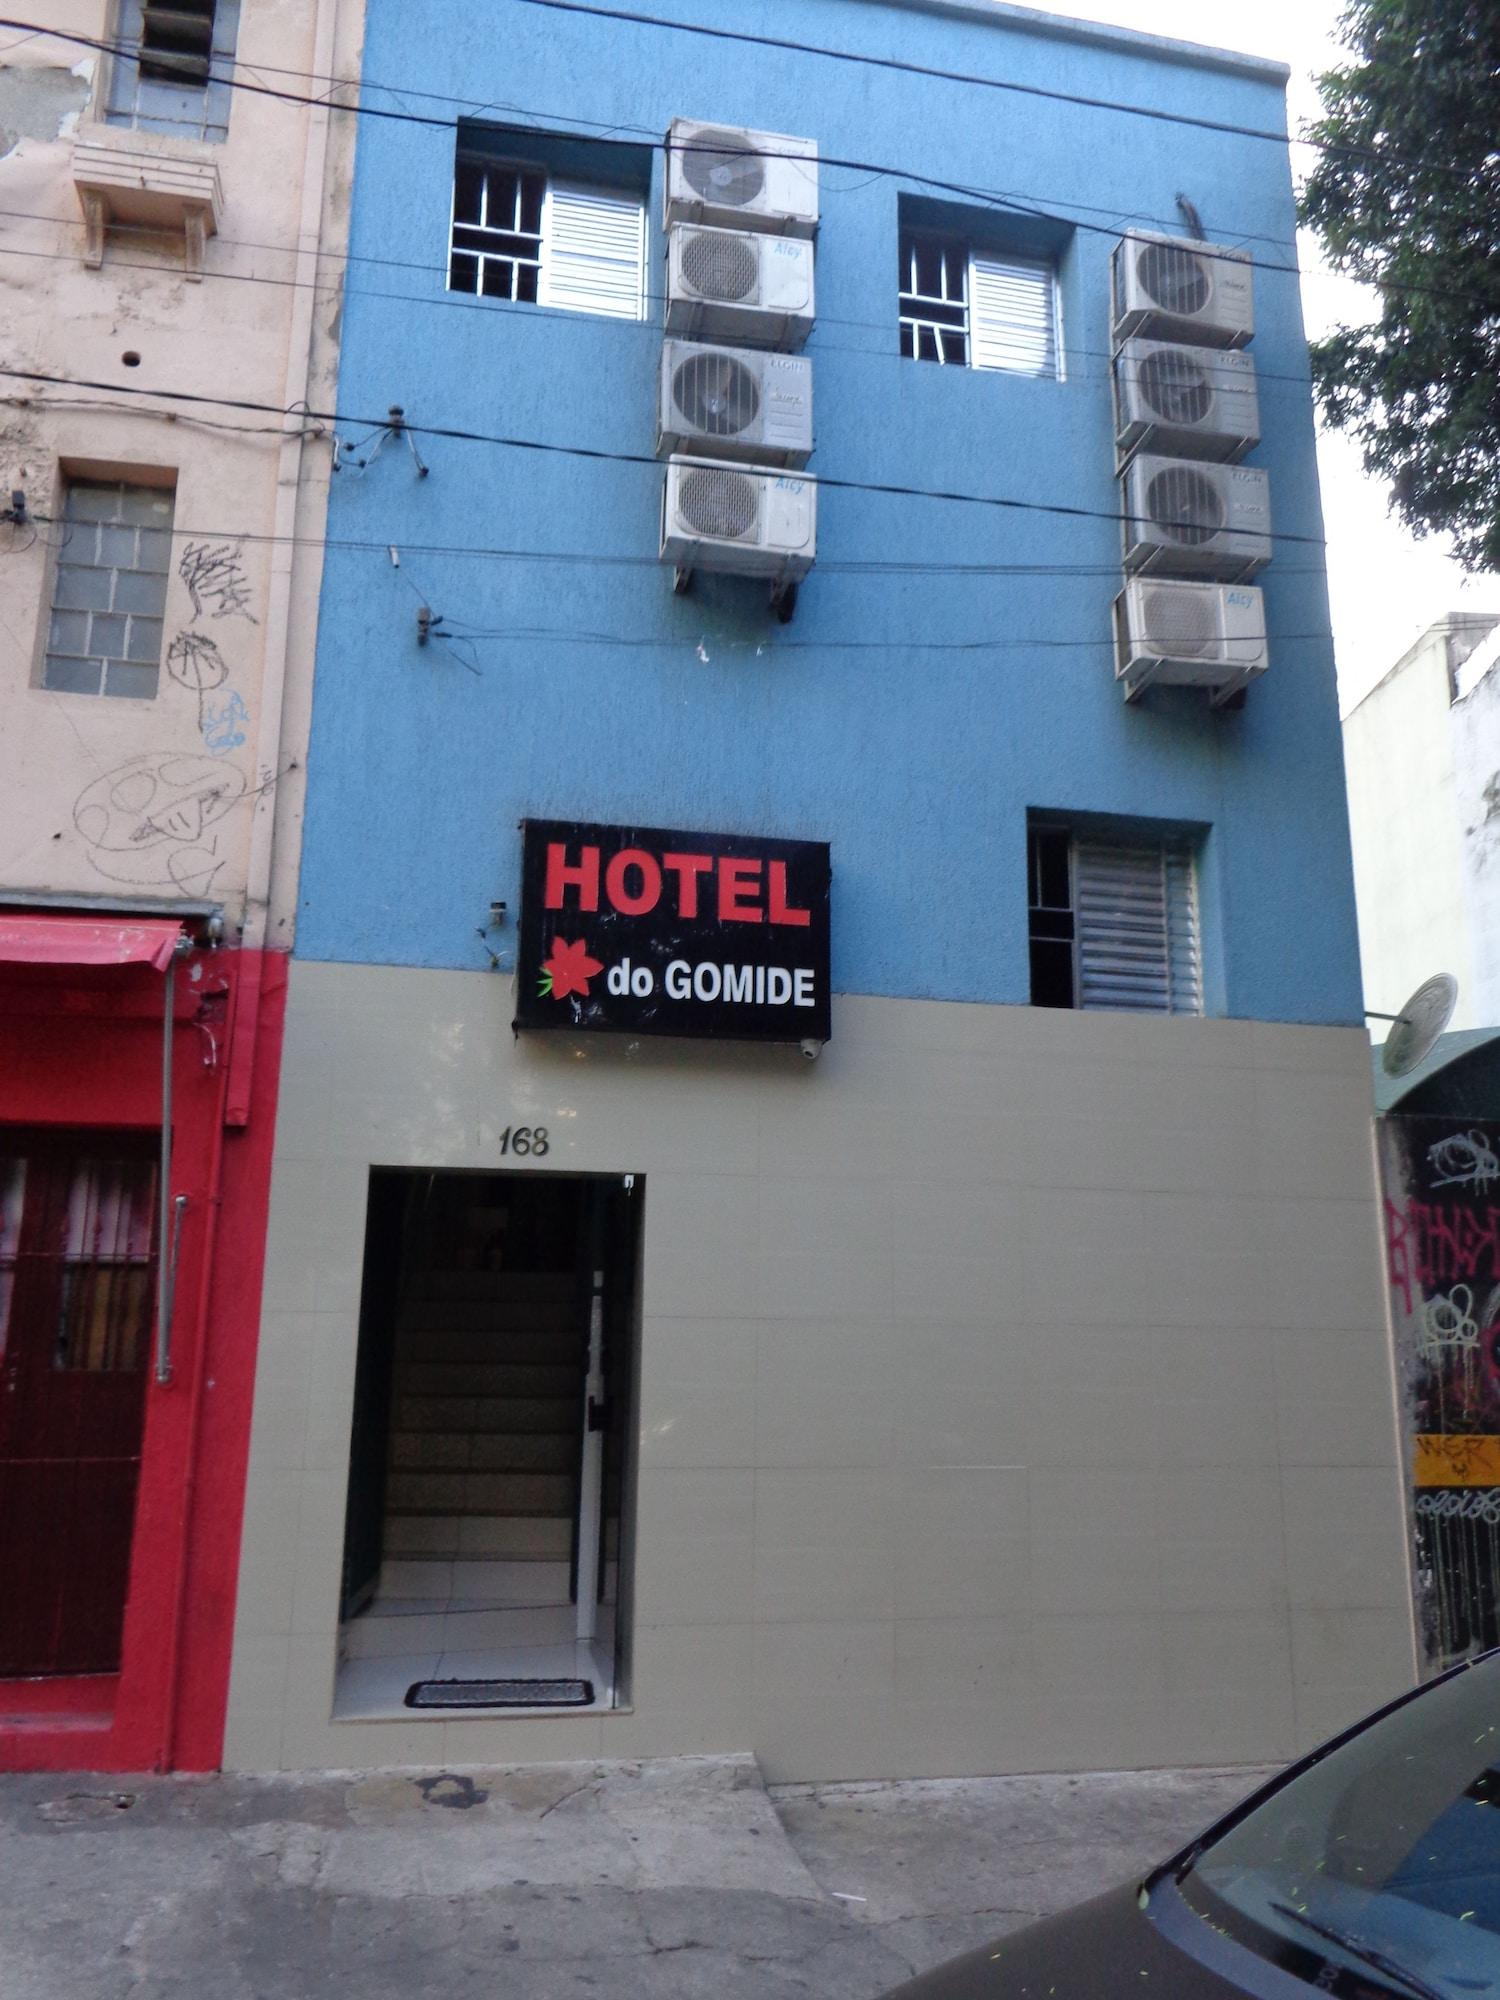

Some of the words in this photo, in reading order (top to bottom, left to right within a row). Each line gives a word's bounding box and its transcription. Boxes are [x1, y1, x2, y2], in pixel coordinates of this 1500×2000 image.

[544, 843, 811, 927] HOTEL
[607, 957, 654, 997] do
[665, 959, 816, 1007] GOMIDE
[499, 1126, 549, 1157] 168
